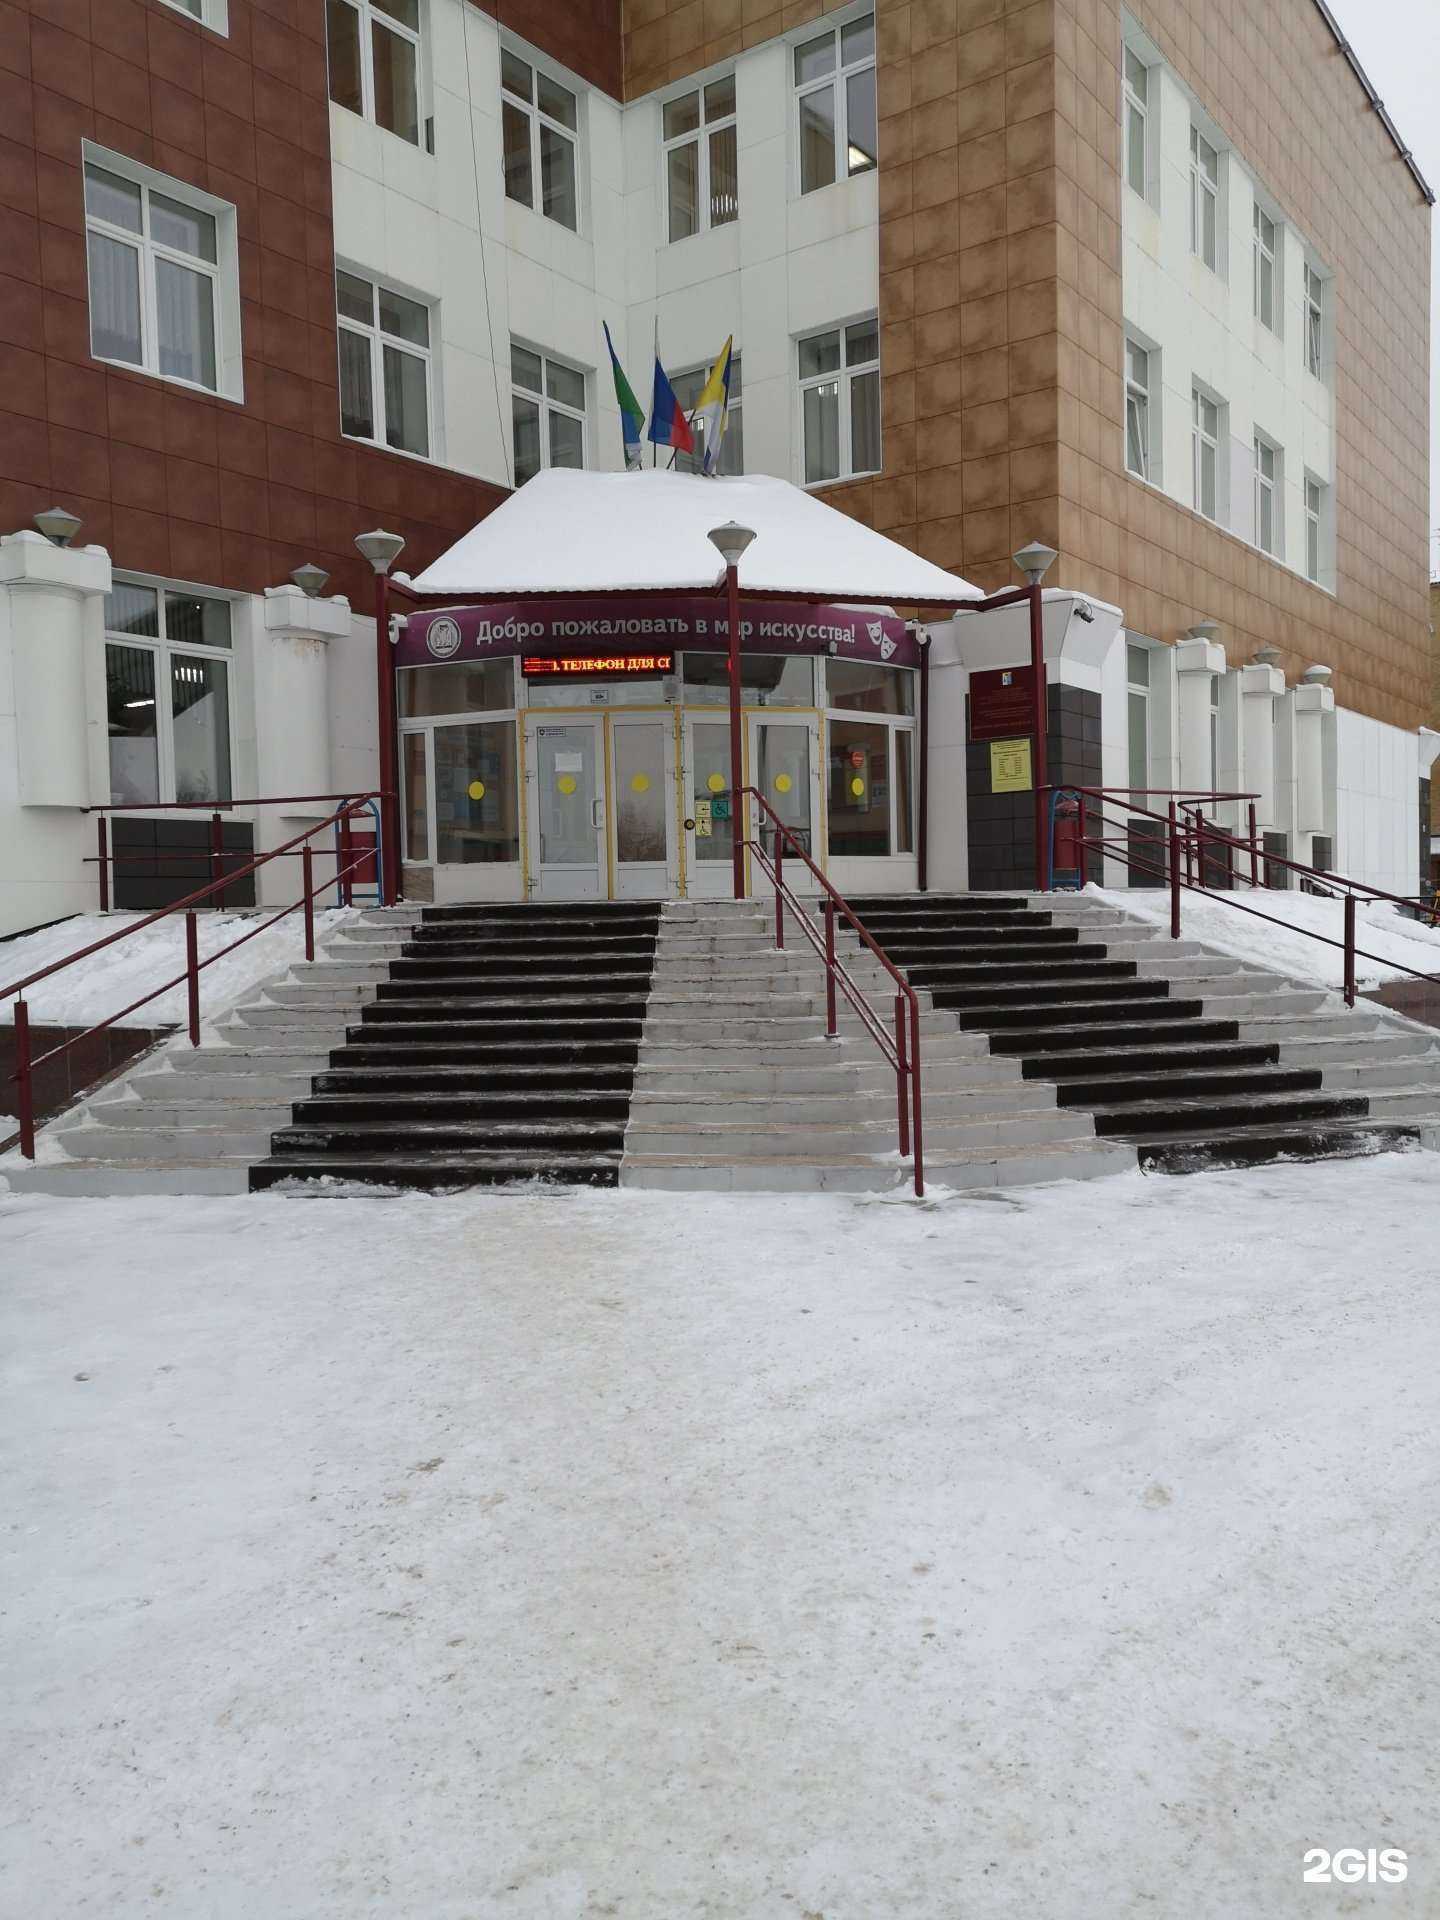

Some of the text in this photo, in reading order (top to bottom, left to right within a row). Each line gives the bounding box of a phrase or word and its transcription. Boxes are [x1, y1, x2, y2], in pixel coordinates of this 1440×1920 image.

[476, 616, 545, 645] Добро
[551, 617, 689, 636] пожаловать
[695, 619, 708, 634] в
[714, 620, 754, 641] мр
[759, 621, 856, 643] искусства!
[561, 658, 625, 671] ТЕЛЕФОН
[627, 657, 655, 671] ДЛЯ
